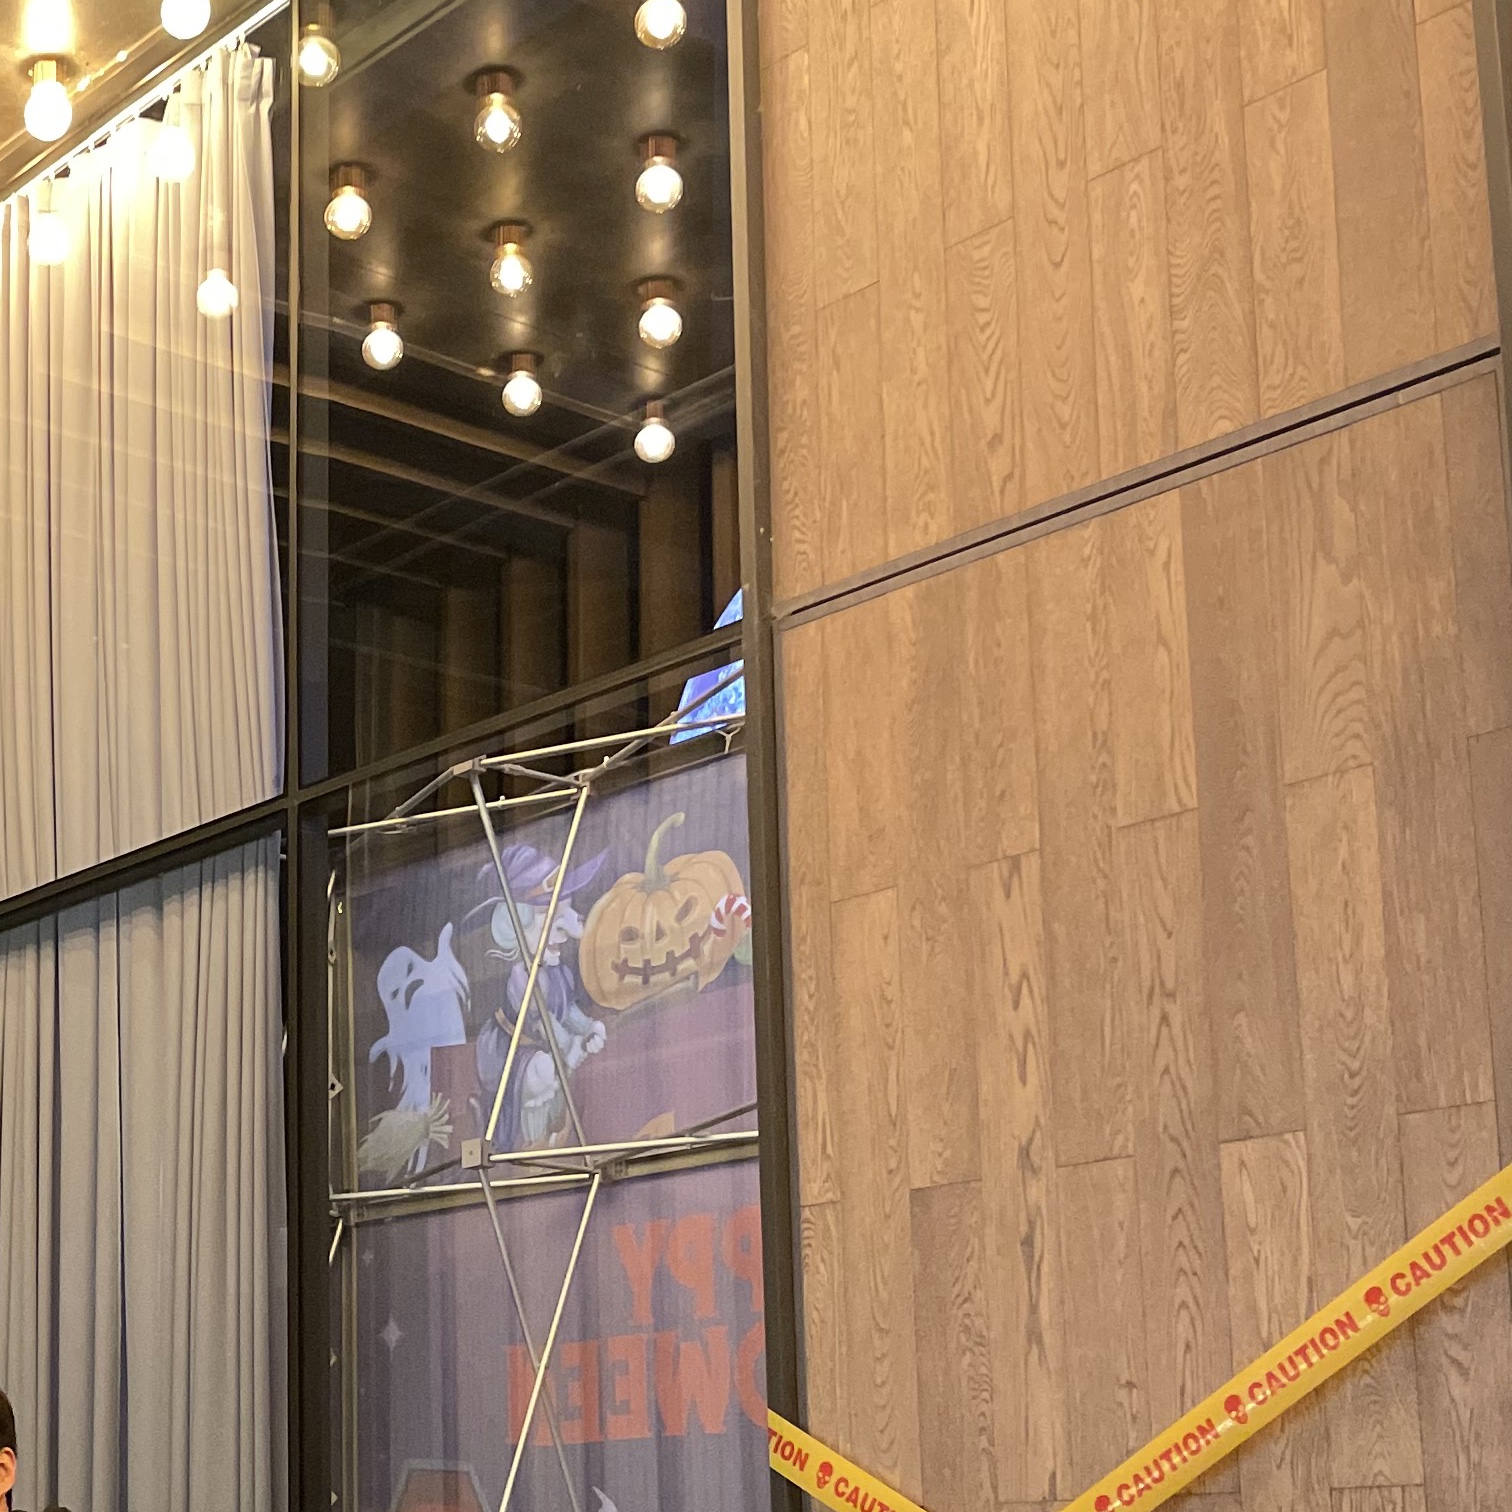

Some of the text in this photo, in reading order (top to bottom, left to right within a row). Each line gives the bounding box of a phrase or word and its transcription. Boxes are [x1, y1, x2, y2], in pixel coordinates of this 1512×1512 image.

[1115, 1418, 1221, 1509] CAUTION
[1246, 1310, 1361, 1408] CAUTION
[1389, 1196, 1512, 1298] CAUTION
